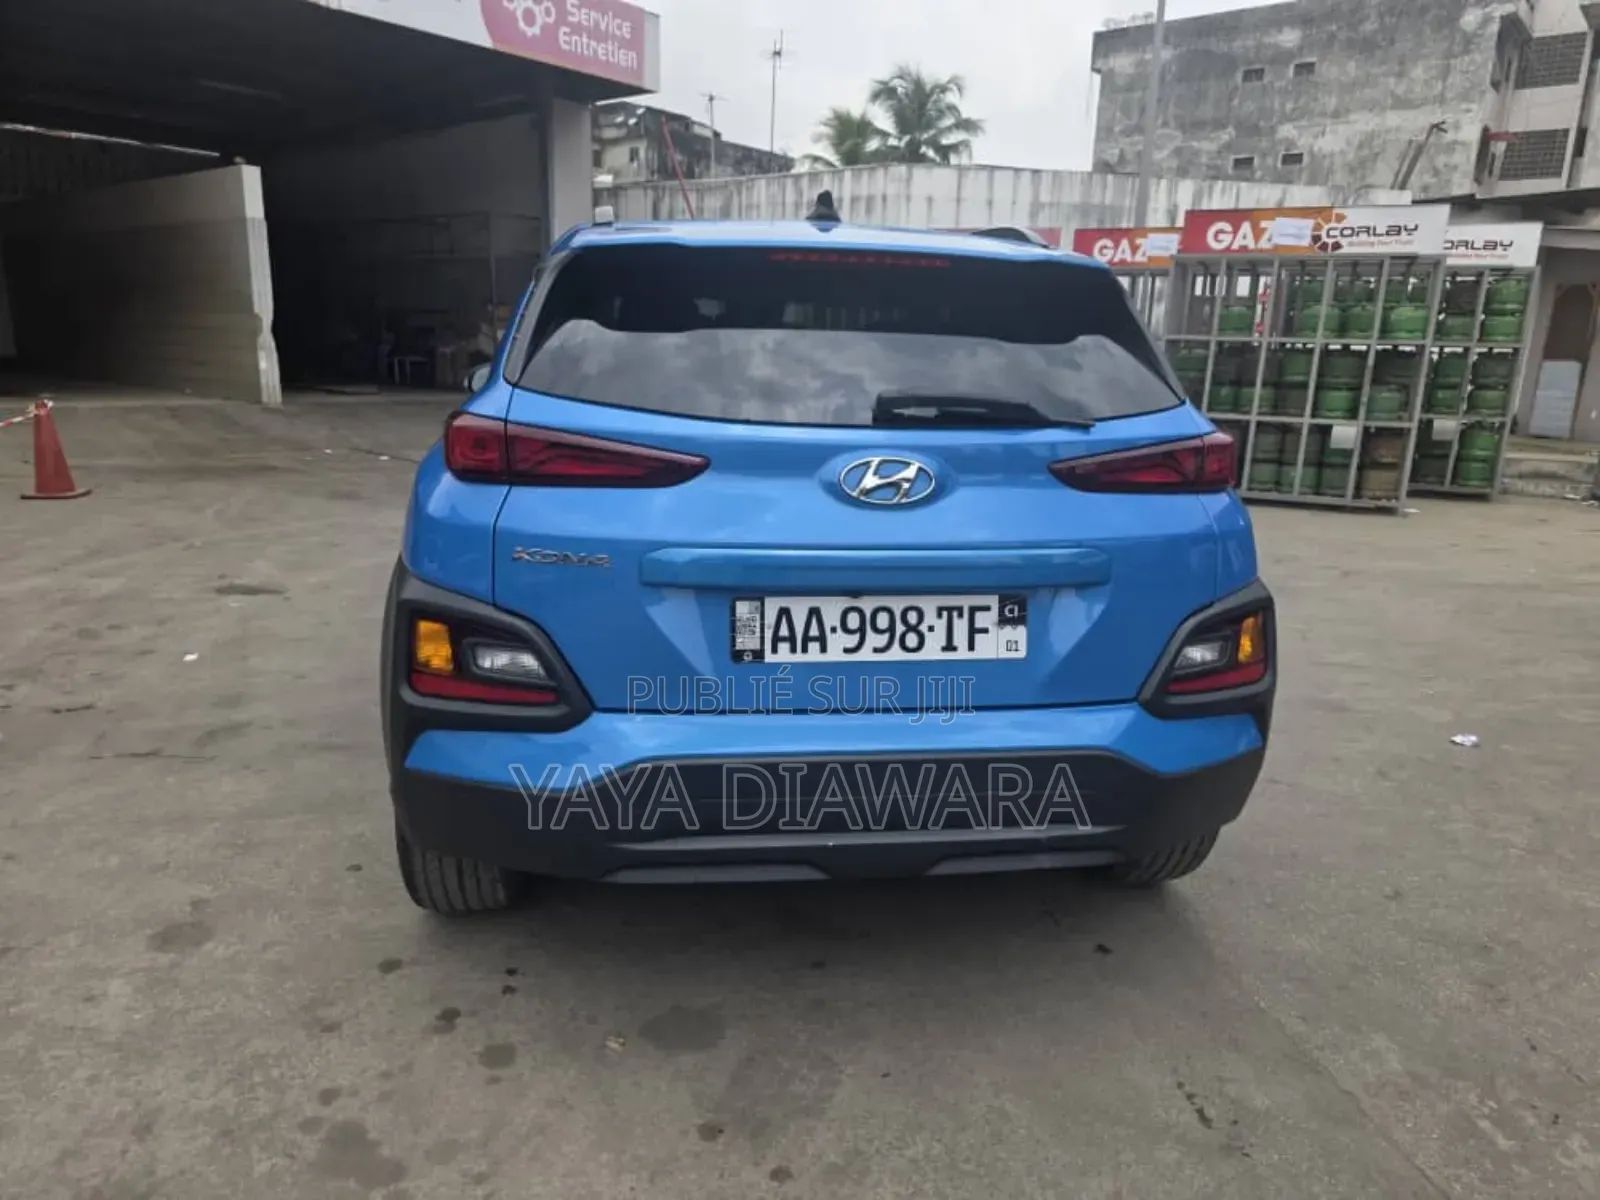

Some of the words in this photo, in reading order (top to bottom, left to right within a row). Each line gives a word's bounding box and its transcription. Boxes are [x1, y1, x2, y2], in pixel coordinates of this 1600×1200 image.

[567, 0, 632, 39] Service
[559, 27, 638, 70] Entretien
[1206, 220, 1274, 250] GAZ
[1443, 239, 1514, 252] ORLAY
[1093, 238, 1148, 264] GAZ
[511, 546, 609, 567] KONA
